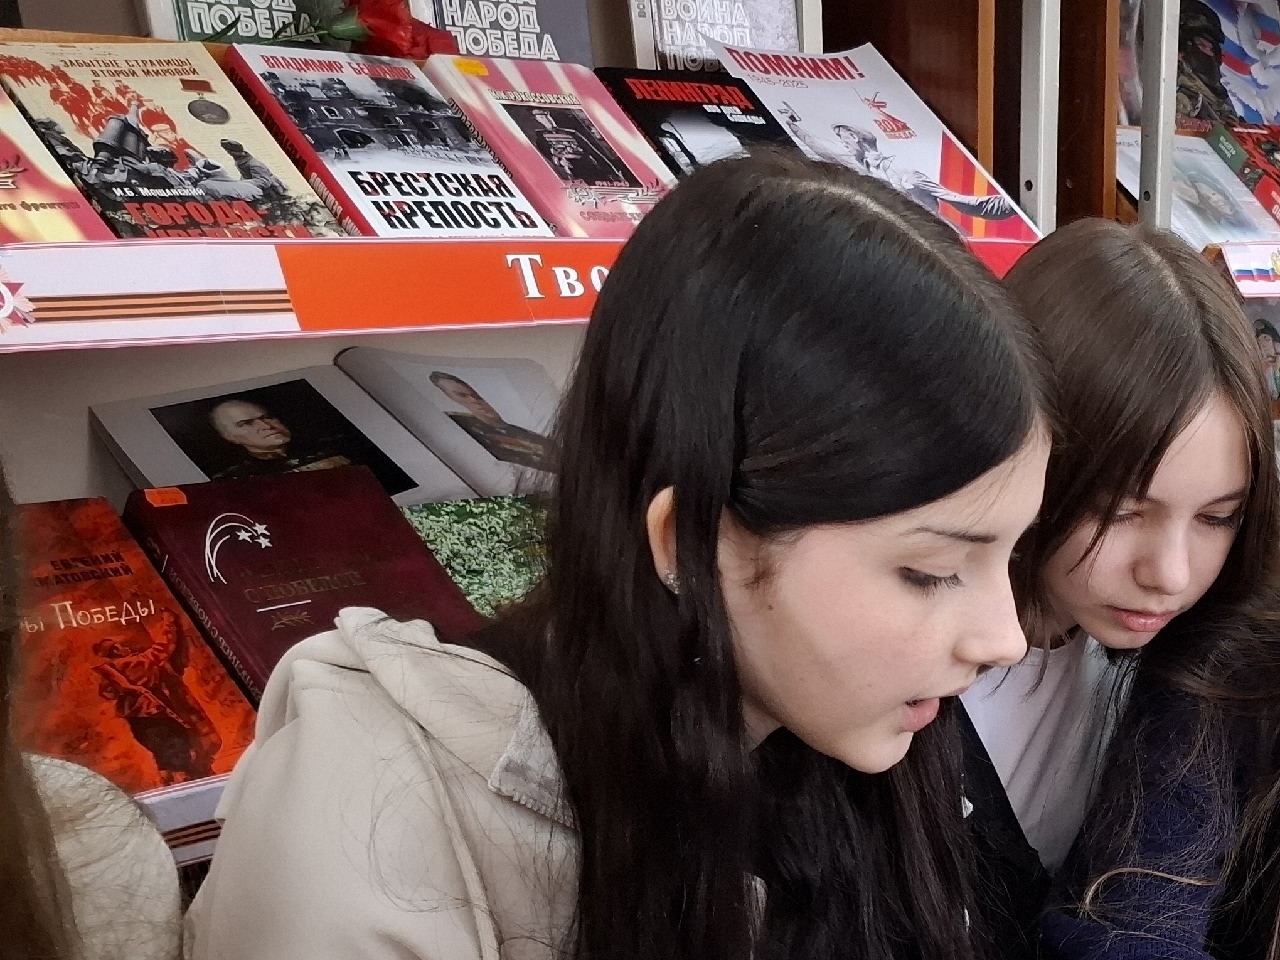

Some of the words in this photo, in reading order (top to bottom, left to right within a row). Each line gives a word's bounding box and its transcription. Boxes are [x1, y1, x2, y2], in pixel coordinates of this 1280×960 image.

[60, 59, 122, 68] ЗАБЫТЫЕ
[124, 58, 192, 68] СТРАНИЦЫ
[92, 68, 139, 78] ВТОРОЙ
[143, 67, 200, 78] МИРОВОЙ
[260, 55, 344, 74] ВЛАДИМИР
[724, 46, 865, 80] ПОМНИМ!
[625, 78, 755, 110] ЛЕНИНГРАД
[347, 171, 516, 198] БРЕСТСКАЯ
[370, 200, 539, 229] КРЕПОСТЬ
